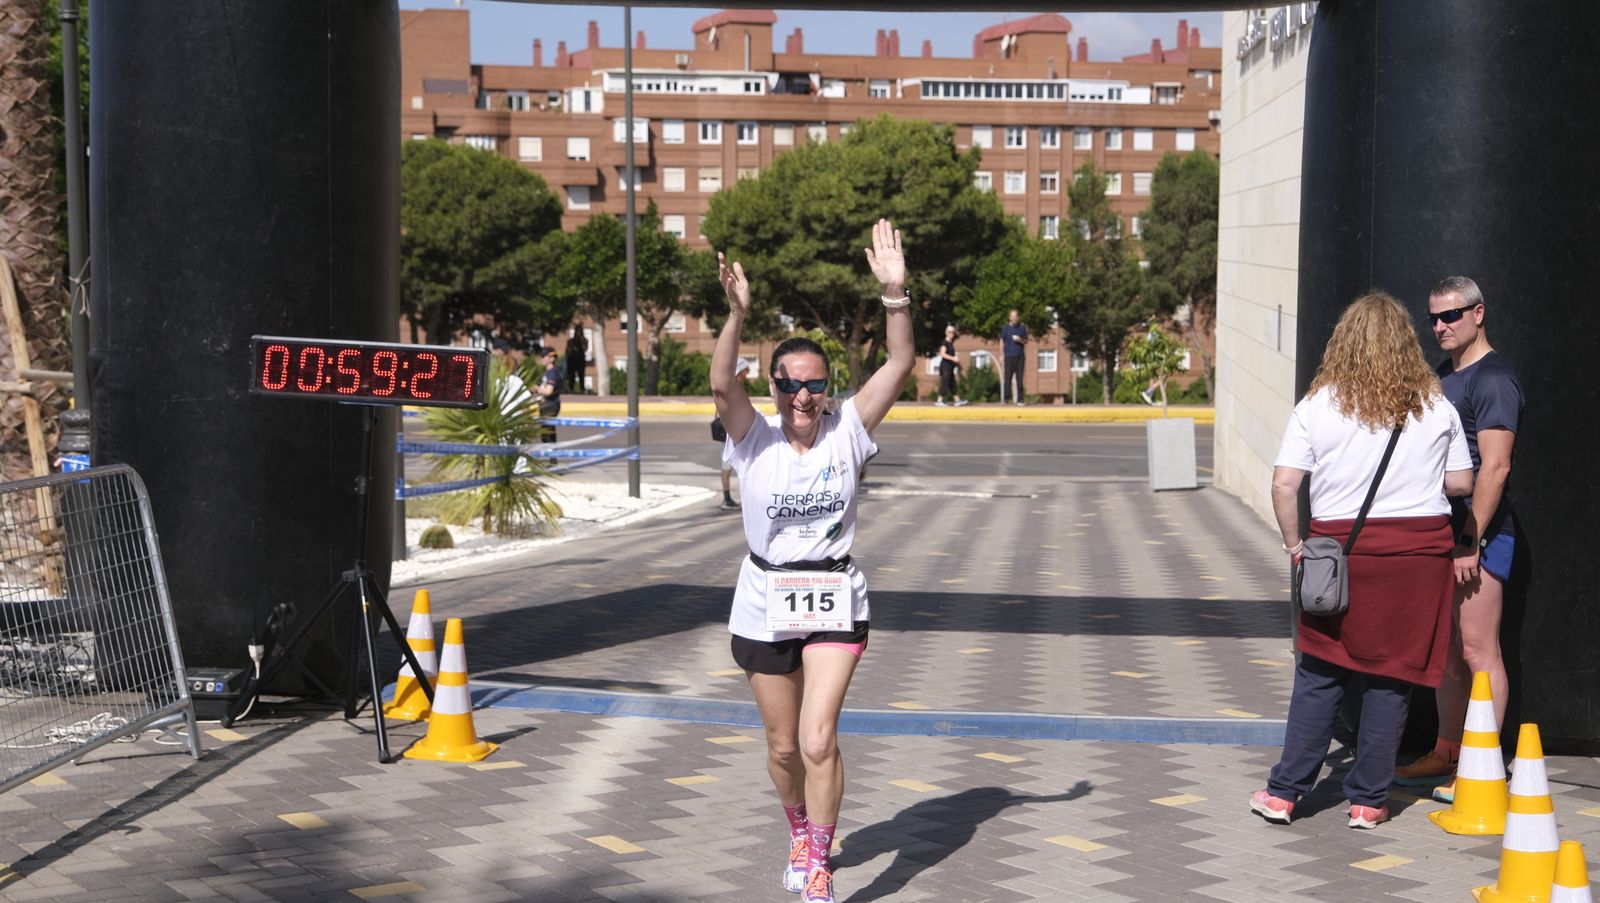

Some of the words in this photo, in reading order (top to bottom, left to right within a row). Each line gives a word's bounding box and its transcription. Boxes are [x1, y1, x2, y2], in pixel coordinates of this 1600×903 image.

[262, 344, 474, 398] 00:59:27
[771, 490, 833, 506] TIERRAS
[766, 500, 845, 520] CANENA
[784, 592, 835, 612] 115
